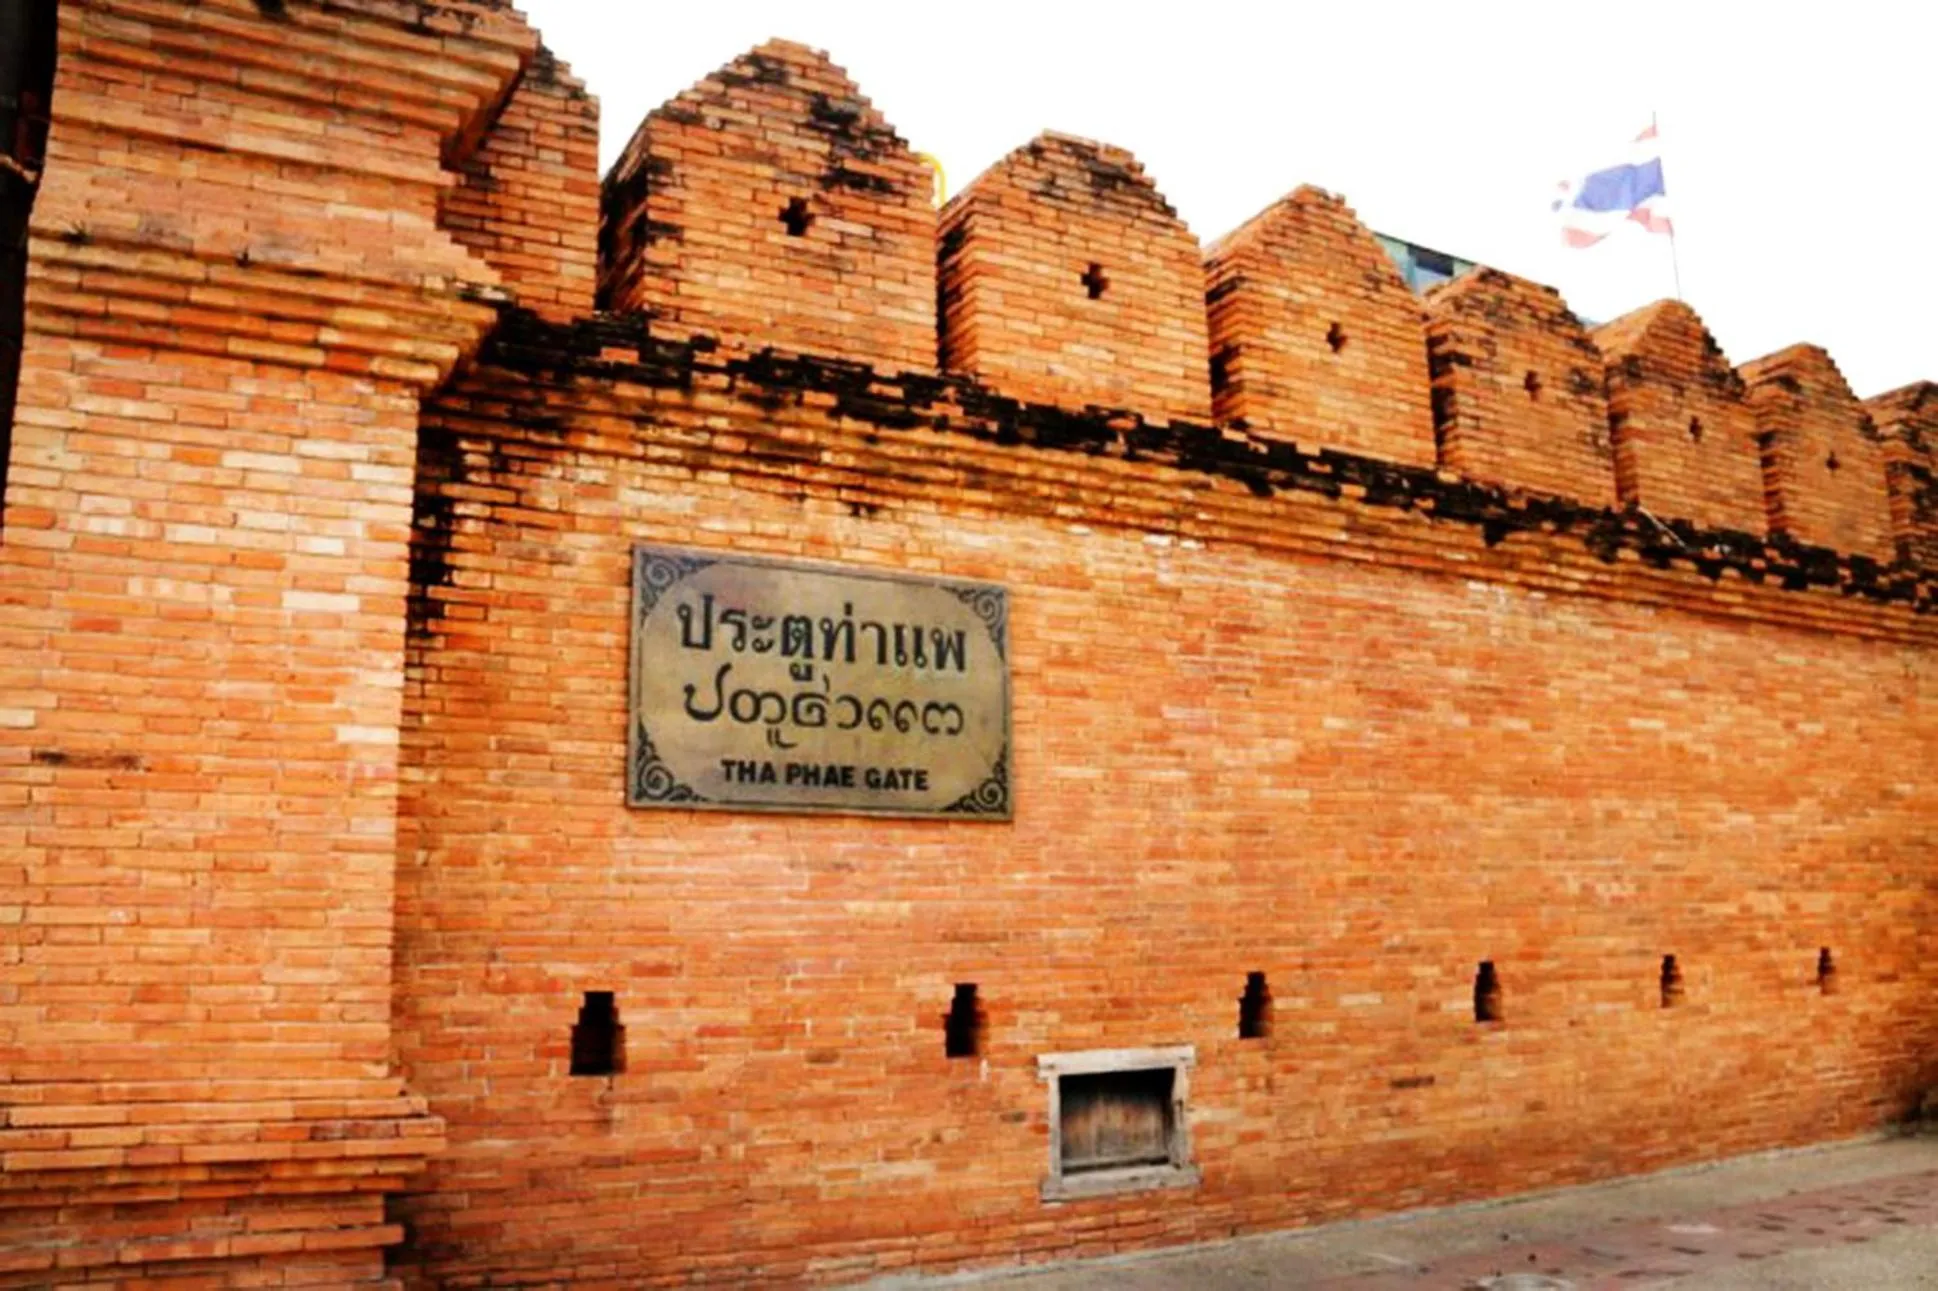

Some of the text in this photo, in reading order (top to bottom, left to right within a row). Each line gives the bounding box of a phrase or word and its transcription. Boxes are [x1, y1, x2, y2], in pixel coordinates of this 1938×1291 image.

[676, 594, 967, 682] ประตูท่าแพ
[721, 759, 929, 791] THA PHAE GATE
